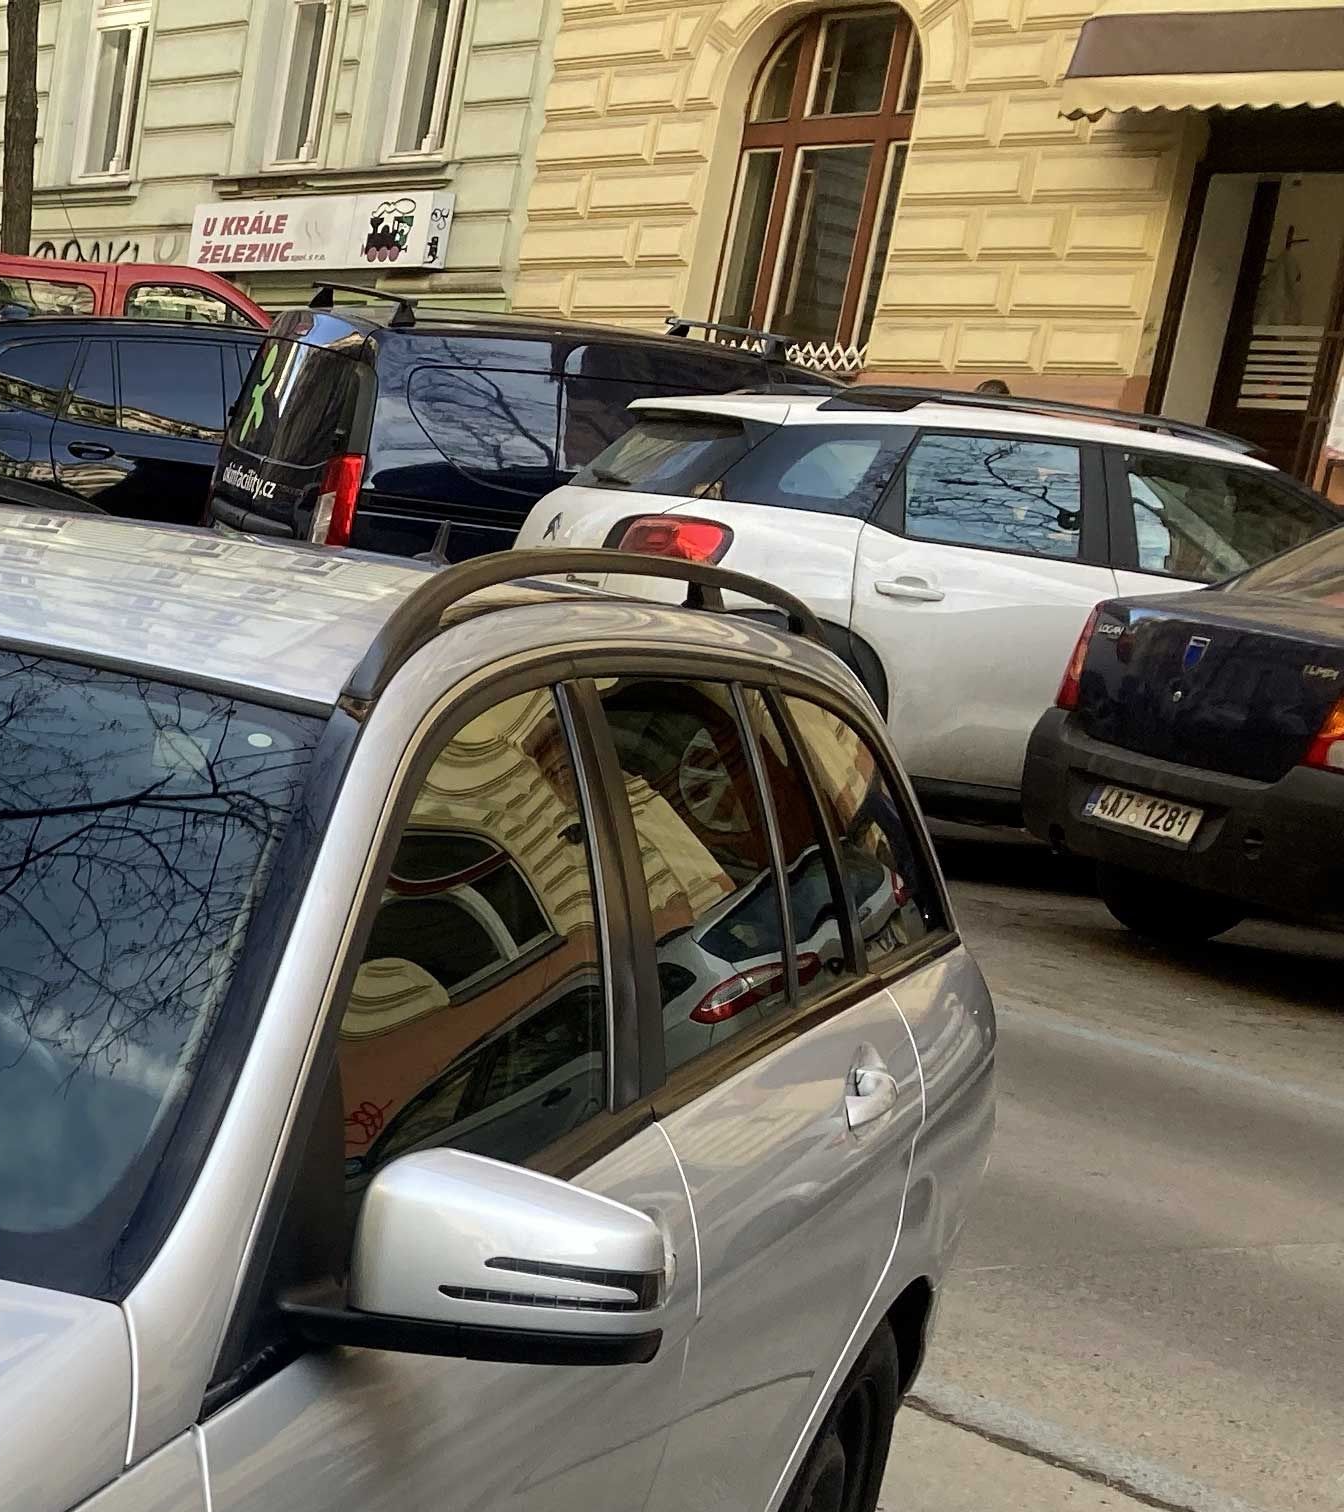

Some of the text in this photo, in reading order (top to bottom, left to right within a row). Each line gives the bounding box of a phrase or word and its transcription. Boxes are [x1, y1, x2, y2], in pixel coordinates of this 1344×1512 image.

[202, 210, 289, 237] U KRÁLE
[197, 239, 294, 264] ŽELEZNIC
[1143, 800, 1192, 837] 1281
